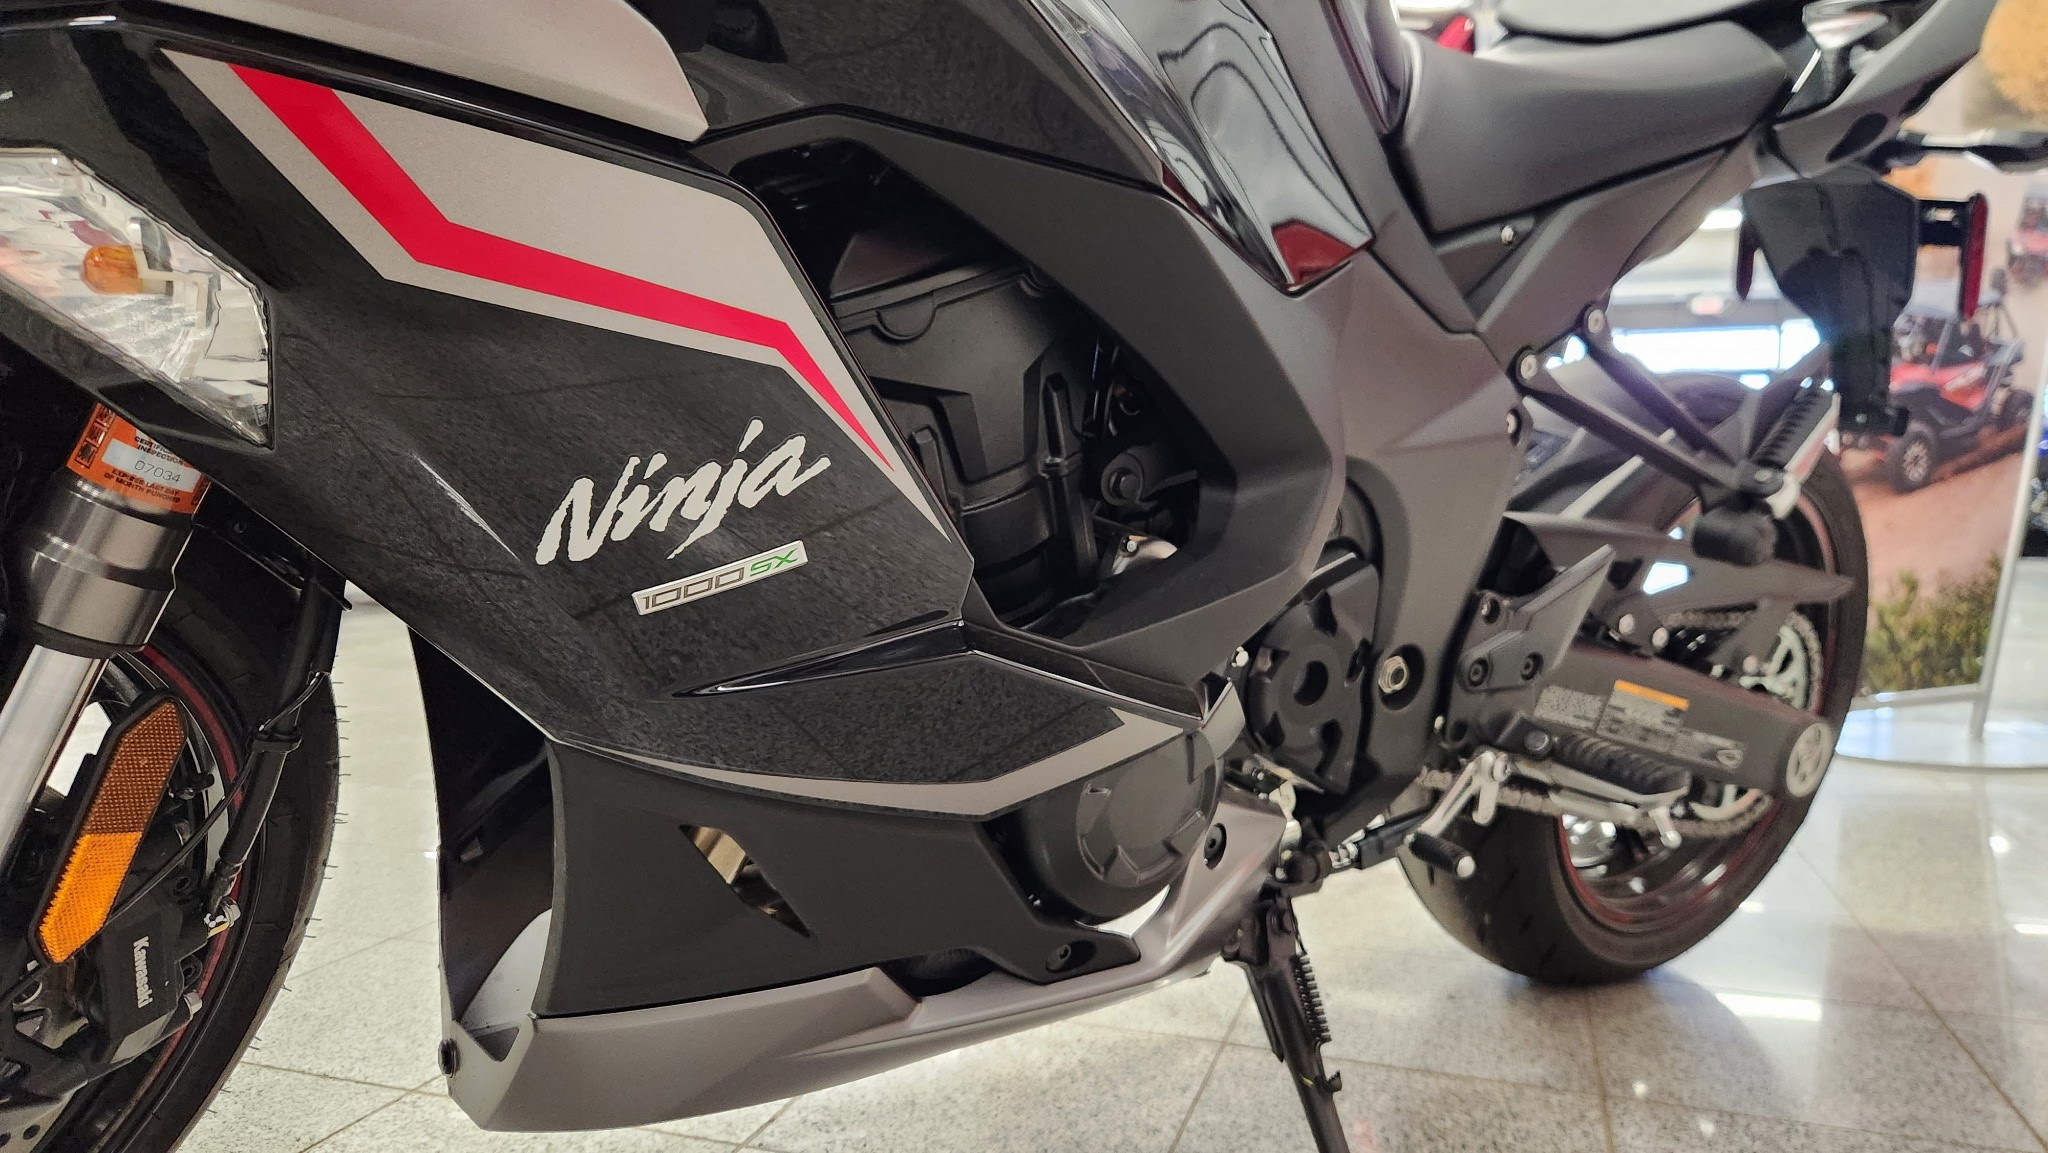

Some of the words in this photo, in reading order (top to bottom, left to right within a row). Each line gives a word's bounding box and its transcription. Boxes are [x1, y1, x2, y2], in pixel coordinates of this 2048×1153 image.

[137, 444, 183, 465] INSPECTION
[104, 472, 114, 480] OF
[115, 476, 144, 492] MONTH
[134, 460, 181, 483] 07034
[146, 481, 164, 491] LAST
[535, 419, 831, 565] Ninja
[642, 547, 799, 610] 1000SX
[133, 936, 153, 1008] Kawasaki
